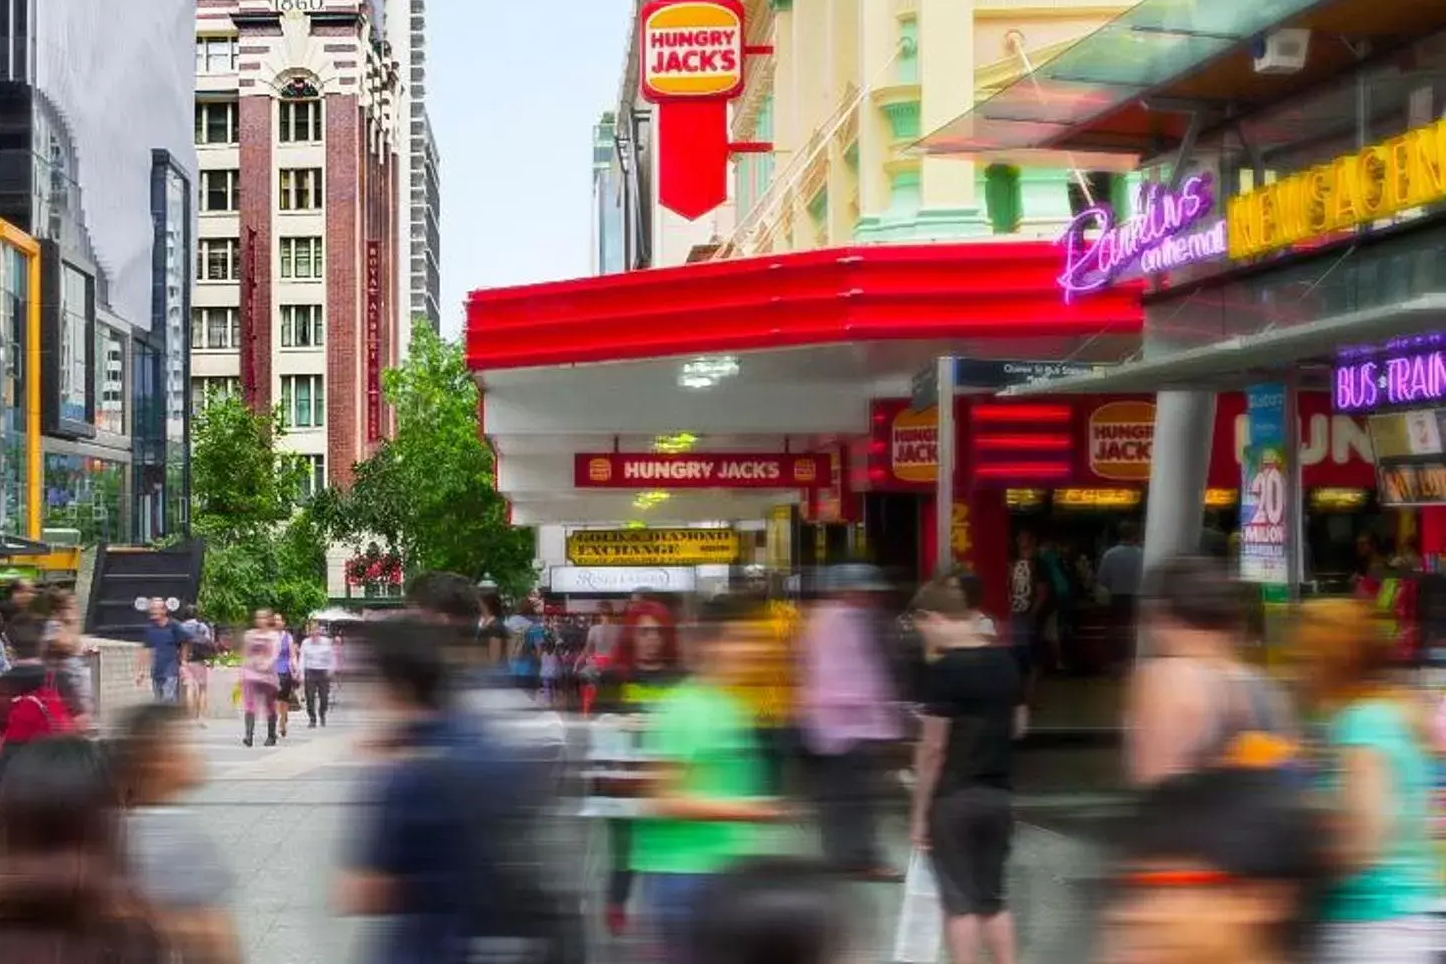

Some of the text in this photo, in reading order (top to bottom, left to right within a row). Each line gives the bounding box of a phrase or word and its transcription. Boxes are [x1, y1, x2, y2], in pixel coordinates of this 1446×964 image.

[651, 30, 735, 48] HUNGRY
[1227, 113, 1446, 261] NEWSAGEN
[1337, 361, 1378, 408] BUS
[624, 460, 711, 480] HUNGRY
[577, 543, 679, 556] EXCHANGE
